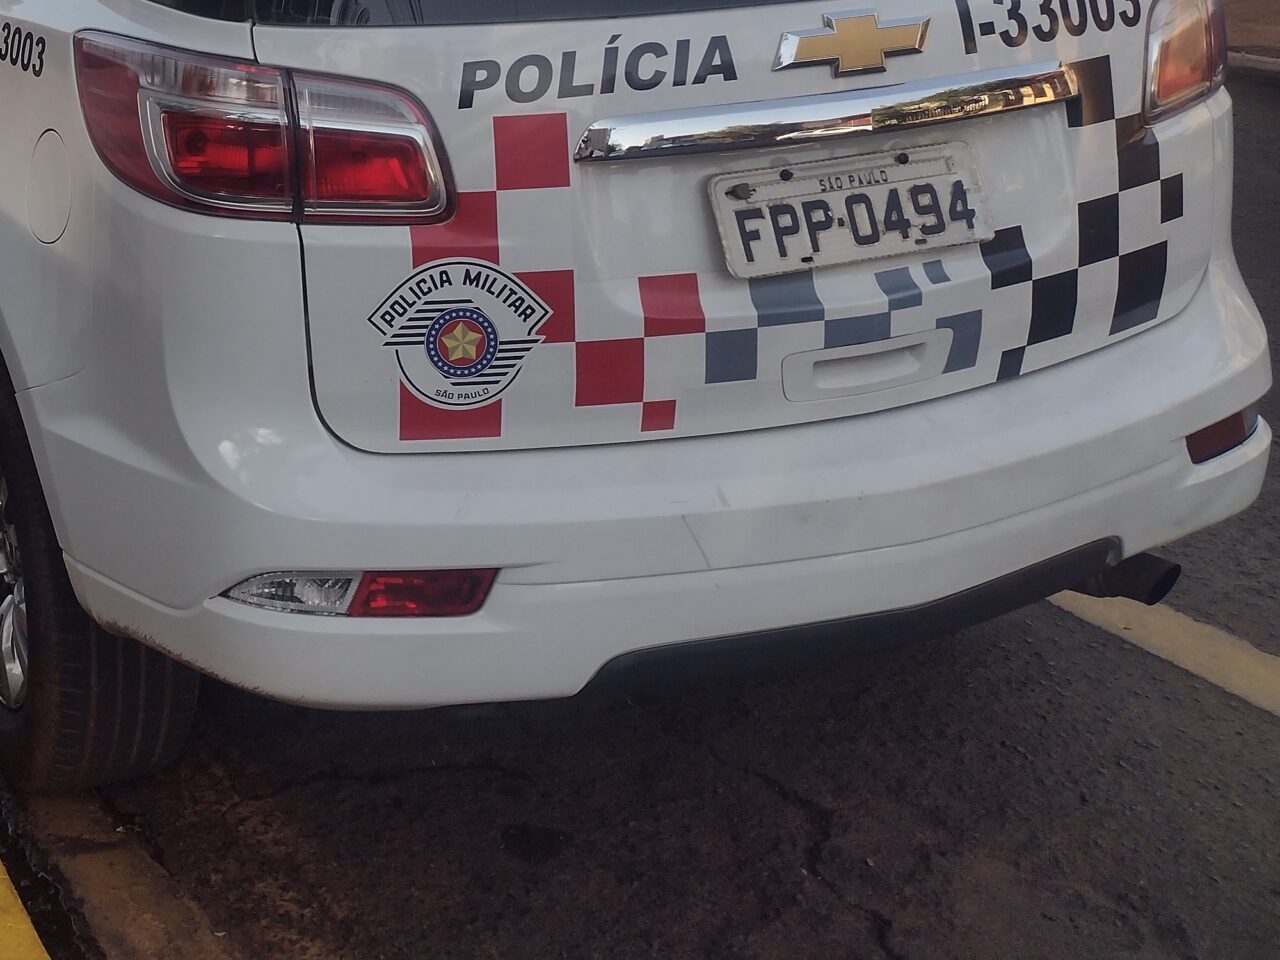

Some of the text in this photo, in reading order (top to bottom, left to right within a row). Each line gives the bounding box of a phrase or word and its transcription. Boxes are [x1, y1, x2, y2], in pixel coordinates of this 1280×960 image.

[458, 34, 738, 109] POLÍCIA
[819, 170, 889, 192] SÃO PAULO
[462, 268, 536, 323] MILITAR
[435, 387, 490, 401] SÃO PAULO
